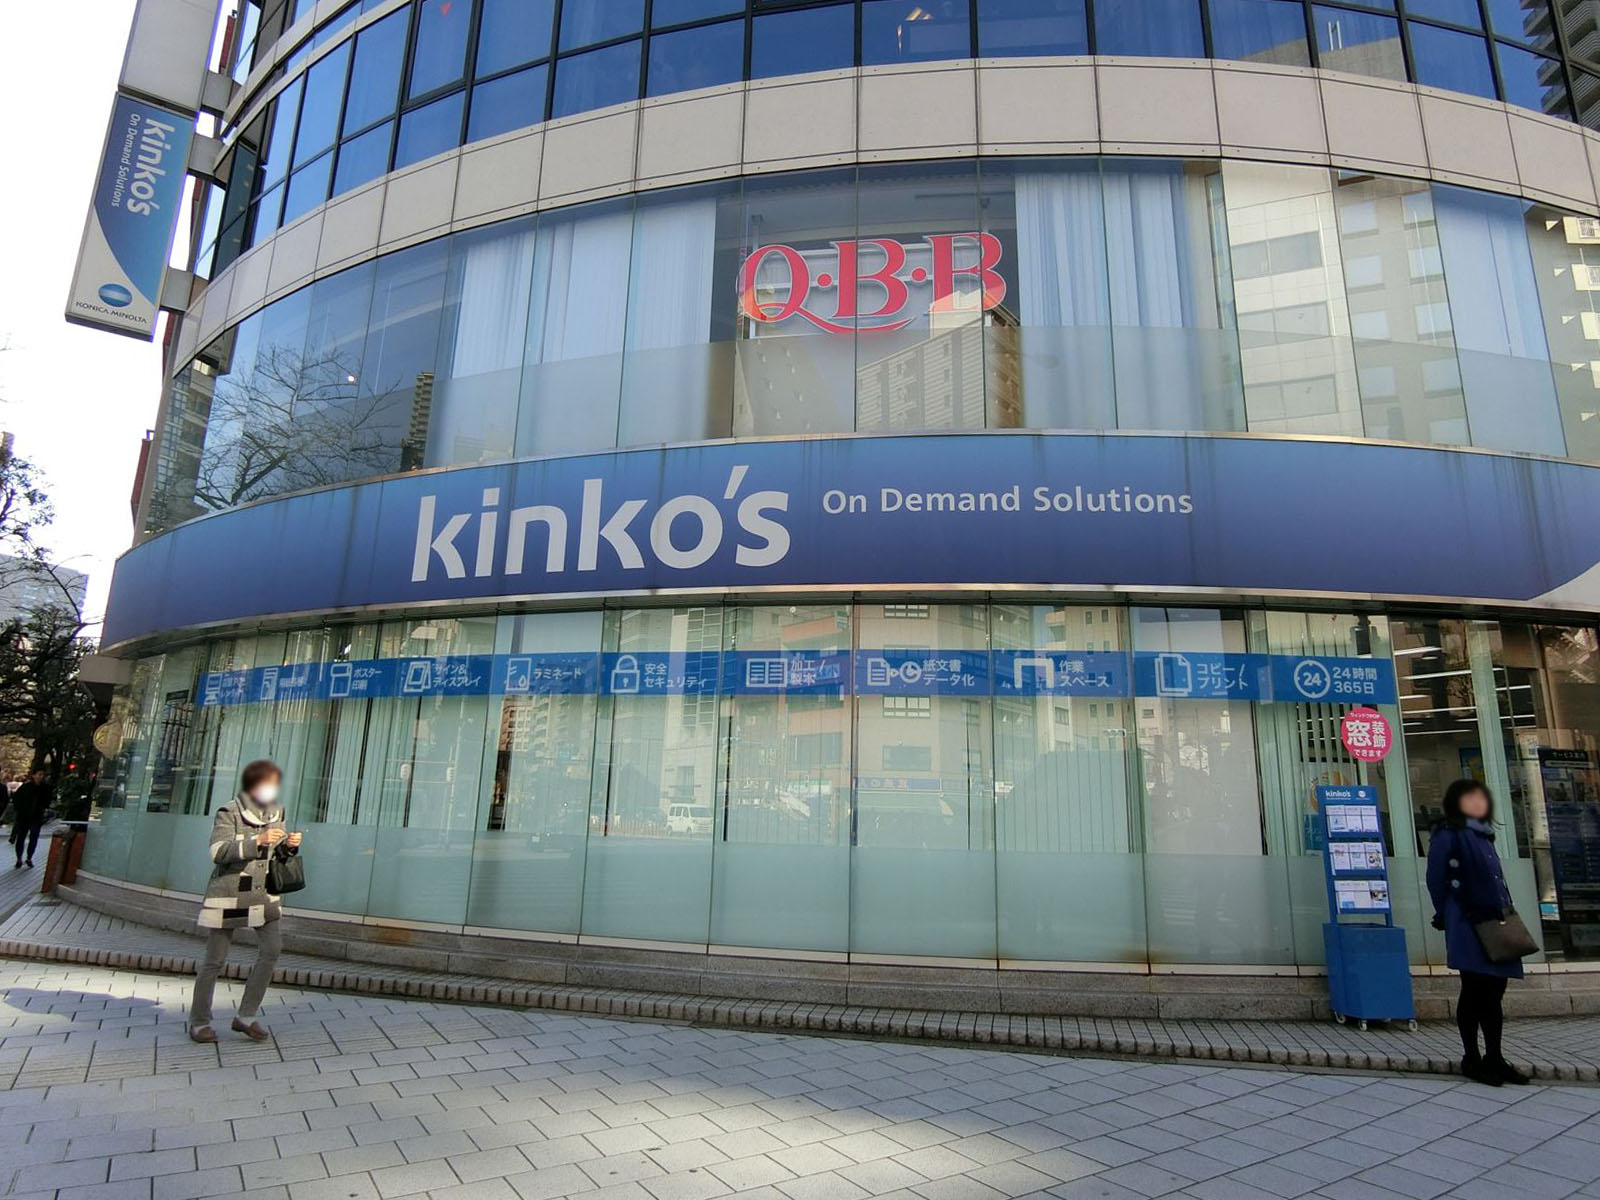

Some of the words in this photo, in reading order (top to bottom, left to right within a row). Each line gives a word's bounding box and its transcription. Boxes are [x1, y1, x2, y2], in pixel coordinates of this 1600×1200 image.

[130, 113, 141, 127] On
[123, 128, 138, 163] Demand
[127, 118, 176, 217] kinko's
[112, 163, 130, 208] Solutions
[75, 301, 109, 315] KONICA
[110, 310, 148, 324] MINOLTA
[822, 489, 867, 514] On
[880, 485, 1020, 512] Demand
[1033, 486, 1193, 514] Solutions
[411, 464, 792, 582] kinko's
[644, 663, 667, 676] 安全
[1059, 659, 1085, 673] 作業
[353, 668, 383, 679] ポスター
[923, 673, 976, 687] データ化
[1303, 672, 1322, 687] 24
[1332, 666, 1378, 681] 24時間
[432, 676, 481, 688] ディスプレイ
[644, 676, 708, 688] セキュリティ
[1059, 675, 1111, 688] スペース
[1197, 677, 1249, 690] プリント
[1334, 681, 1375, 695] 365日
